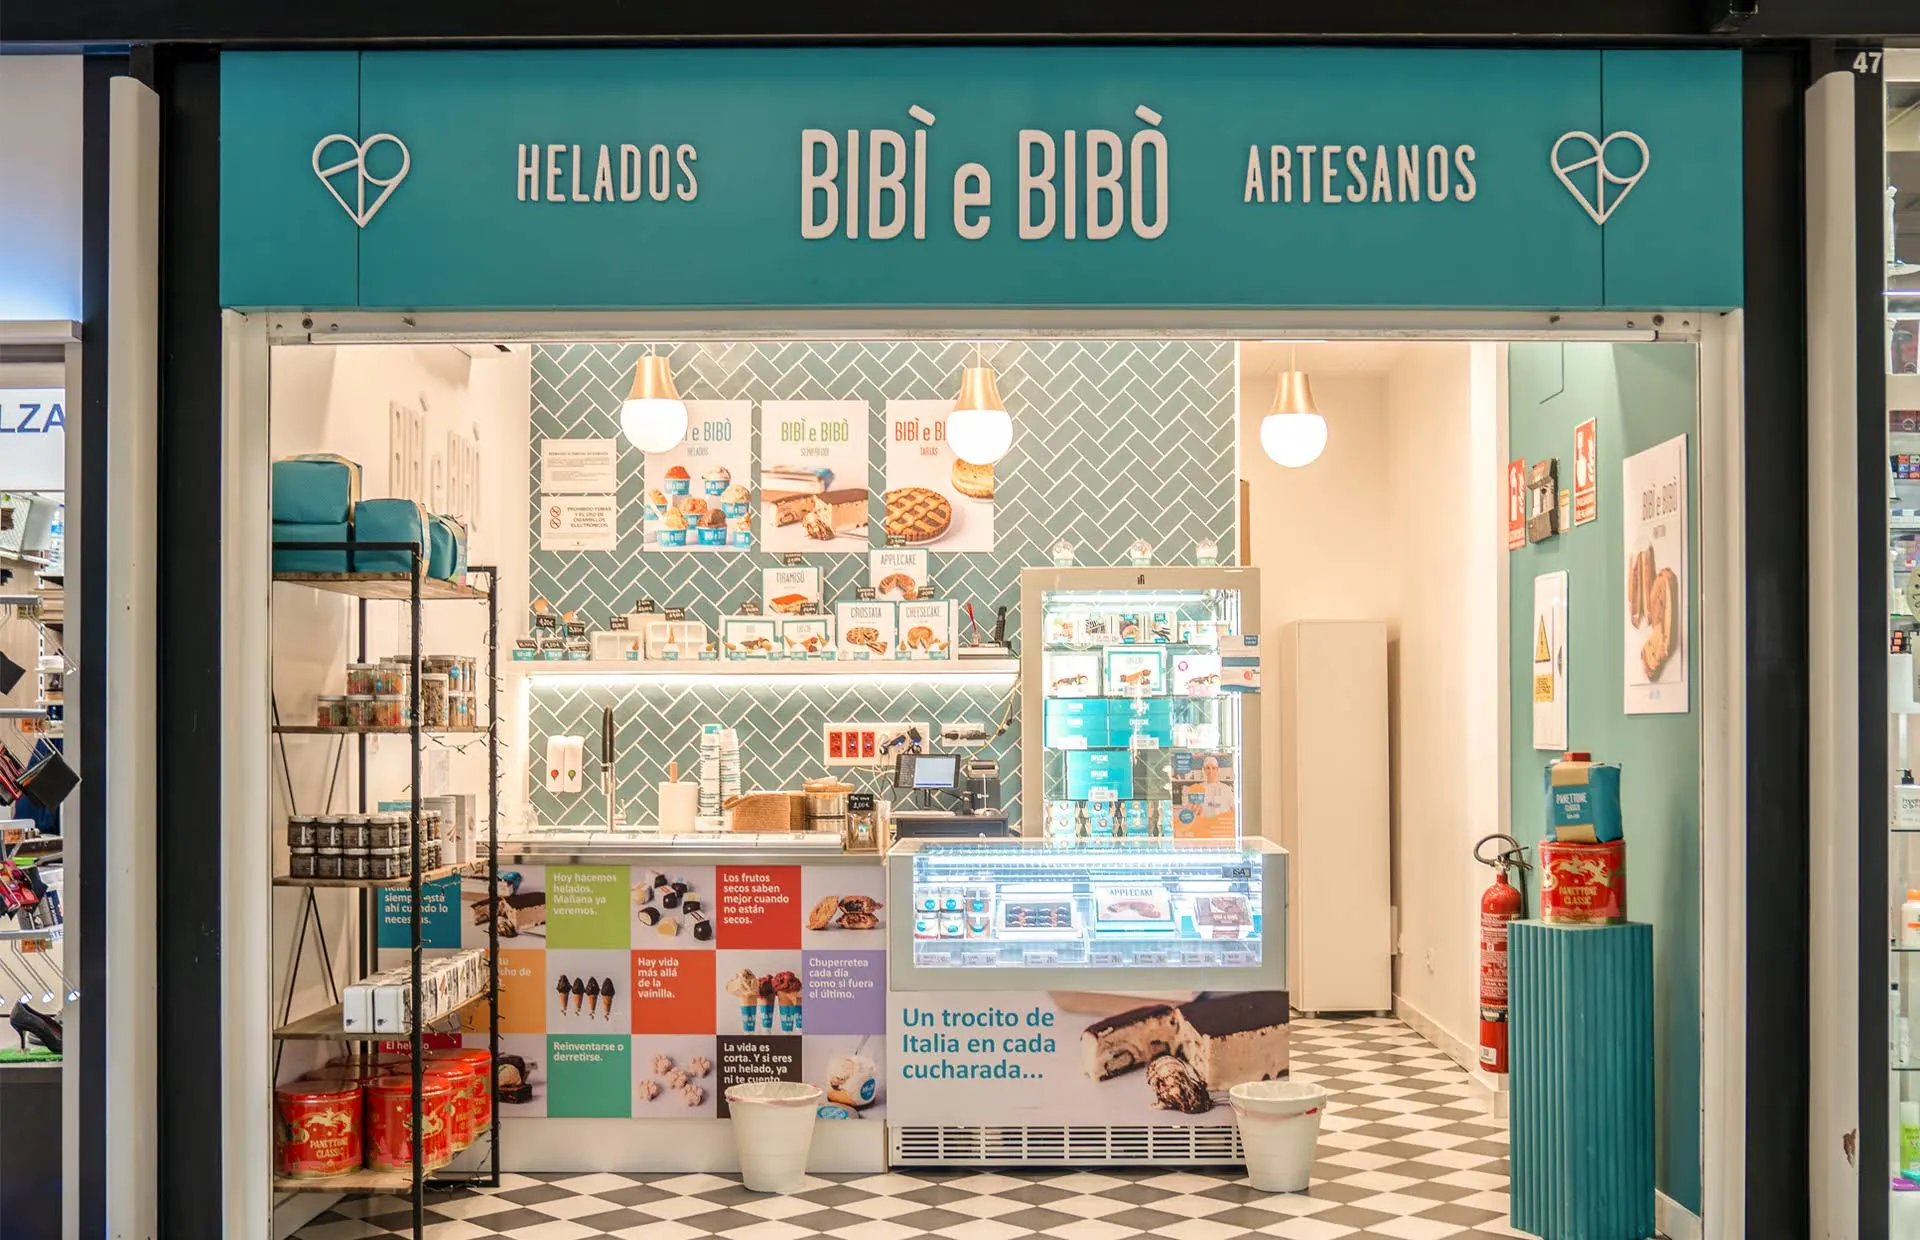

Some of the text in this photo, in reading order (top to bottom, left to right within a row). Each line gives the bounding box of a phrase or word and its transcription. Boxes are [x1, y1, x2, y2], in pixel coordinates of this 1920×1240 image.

[1852, 51, 1883, 75] 47
[517, 143, 699, 203] HELADOS
[800, 103, 1169, 241] BIBÌ e BIBÒ
[1243, 143, 1478, 205] ARTESANOS
[692, 426, 700, 442] e
[703, 418, 732, 442] BIBÒ
[781, 418, 849, 443] BIBÌ e BIBÒ
[895, 417, 920, 442] BIBÌ
[922, 426, 931, 442] e
[553, 872, 617, 884] Hoy hacemos
[723, 872, 771, 883] Los frutos
[553, 883, 594, 893] helados.
[723, 883, 780, 893] secos saben
[384, 893, 412, 906] siemp
[553, 894, 607, 906] Mañana ya
[723, 893, 790, 905] mejor cuando
[384, 903, 449, 913] ahí cundo lo
[553, 907, 598, 916] veremos.
[723, 903, 765, 914] no están
[723, 916, 753, 925] secos.
[638, 957, 679, 968] Hay vida
[808, 957, 869, 969] Chuperretea
[518, 967, 532, 977] de
[638, 967, 678, 977] más allá
[808, 967, 849, 978] cada día
[638, 977, 662, 988] de la
[808, 978, 875, 989] como si fuera
[637, 988, 676, 999] vainilla.
[808, 989, 855, 999] el último.
[902, 1006, 1055, 1029] Un trocito de
[386, 1040, 430, 1051] El helo
[553, 1041, 625, 1052] Reinventarse o
[724, 1042, 770, 1052] La vida es
[902, 1032, 1057, 1054] Italia en cada
[553, 1051, 604, 1062] derretirse.
[723, 1053, 793, 1063] corta. Y si eres
[723, 1063, 788, 1075] un helado, ya
[902, 1058, 1044, 1080] cucharada...
[723, 1075, 734, 1085] ni
[735, 1076, 746, 1084] te
